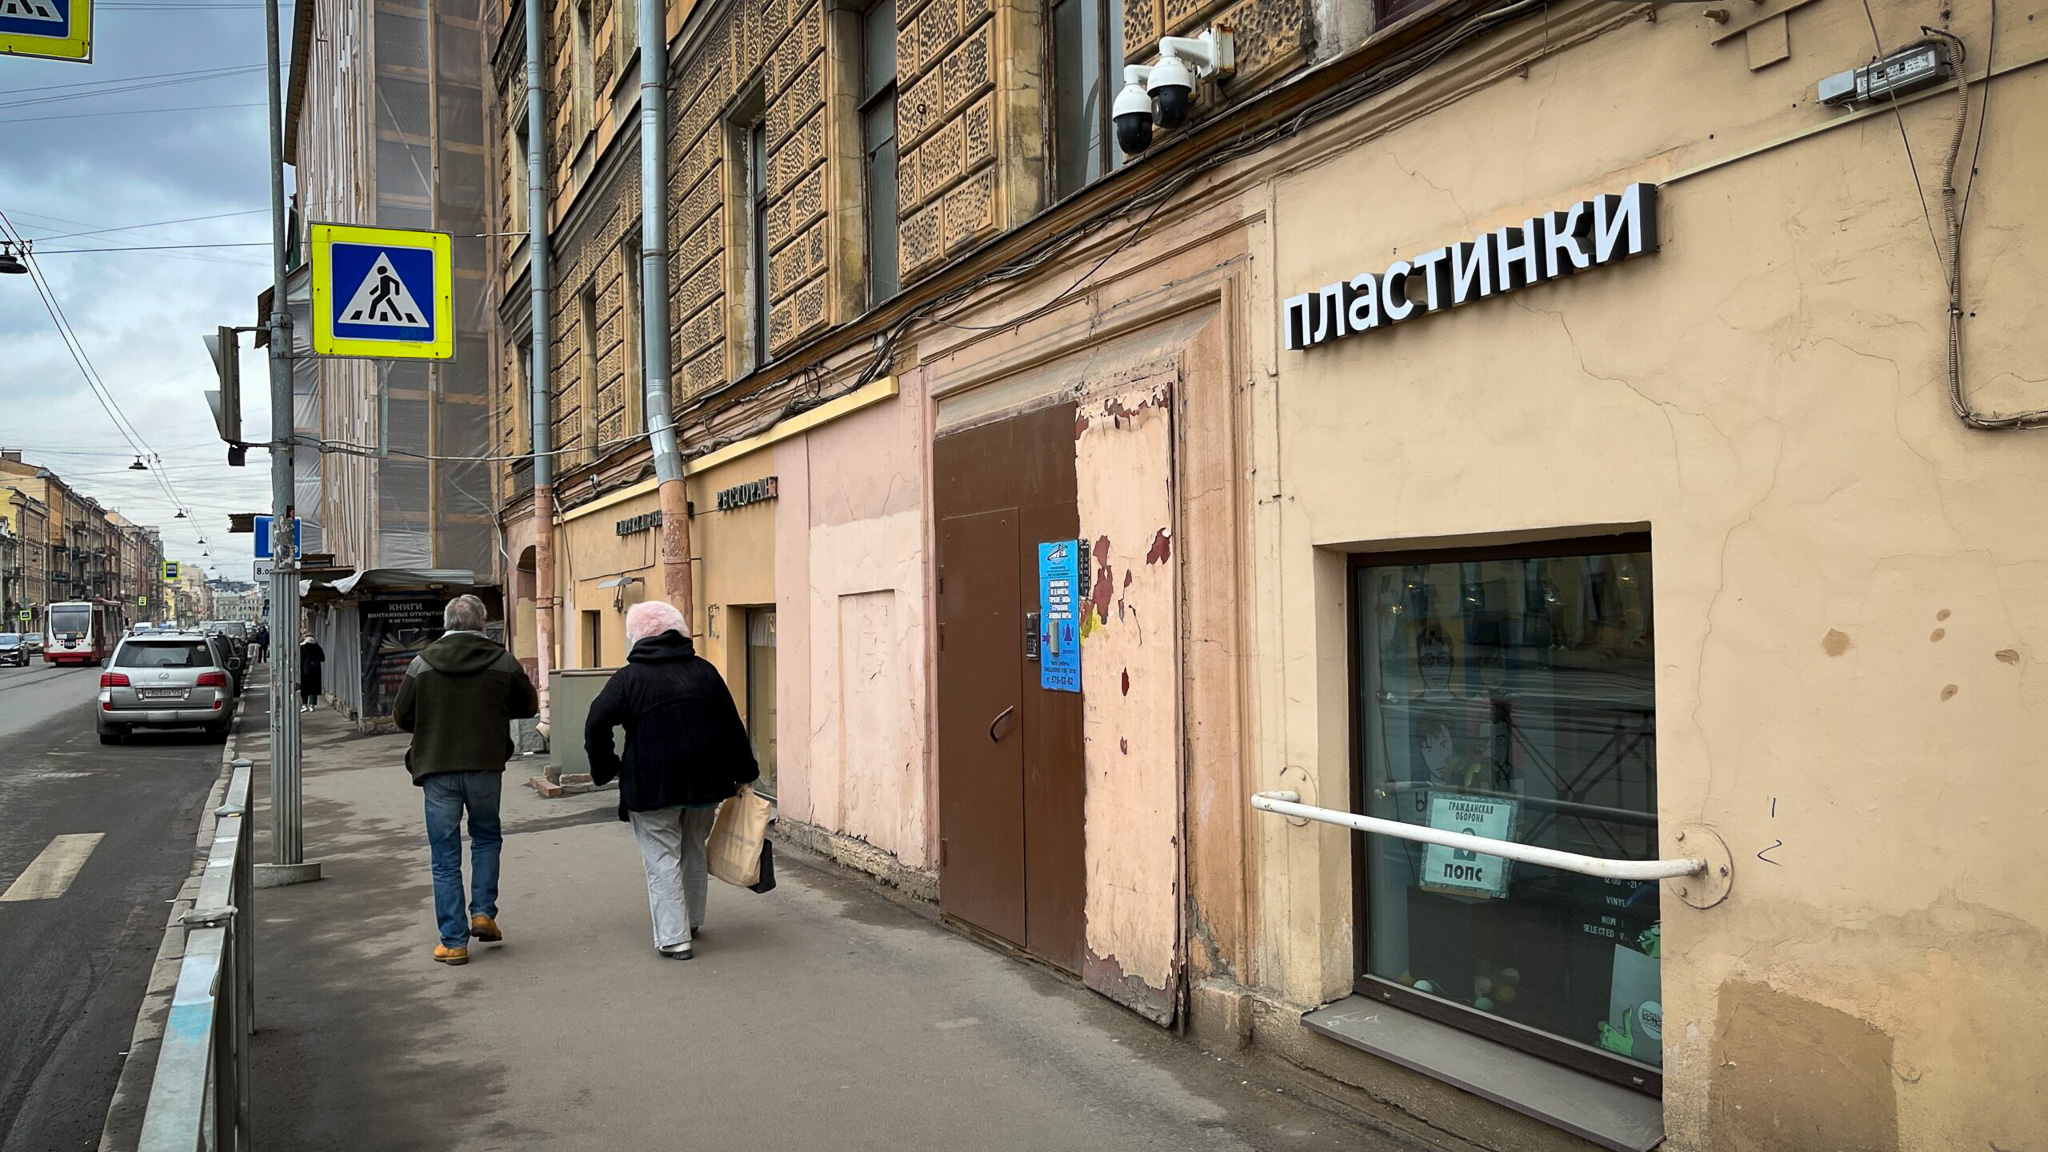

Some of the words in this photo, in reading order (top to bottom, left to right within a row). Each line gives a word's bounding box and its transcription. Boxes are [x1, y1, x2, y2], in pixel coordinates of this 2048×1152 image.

[1284, 182, 1656, 350] пластинки
[717, 476, 778, 511] РЕСТОРАН
[389, 603, 423, 611] КНИГИ
[1448, 801, 1494, 815] ГРАЖДАНСКАЯ
[1455, 811, 1484, 823] ОБОРОНА
[1443, 863, 1483, 882] ПОПС
[1605, 895, 1626, 908] VINYL
[1583, 923, 1615, 938] SELECTED
